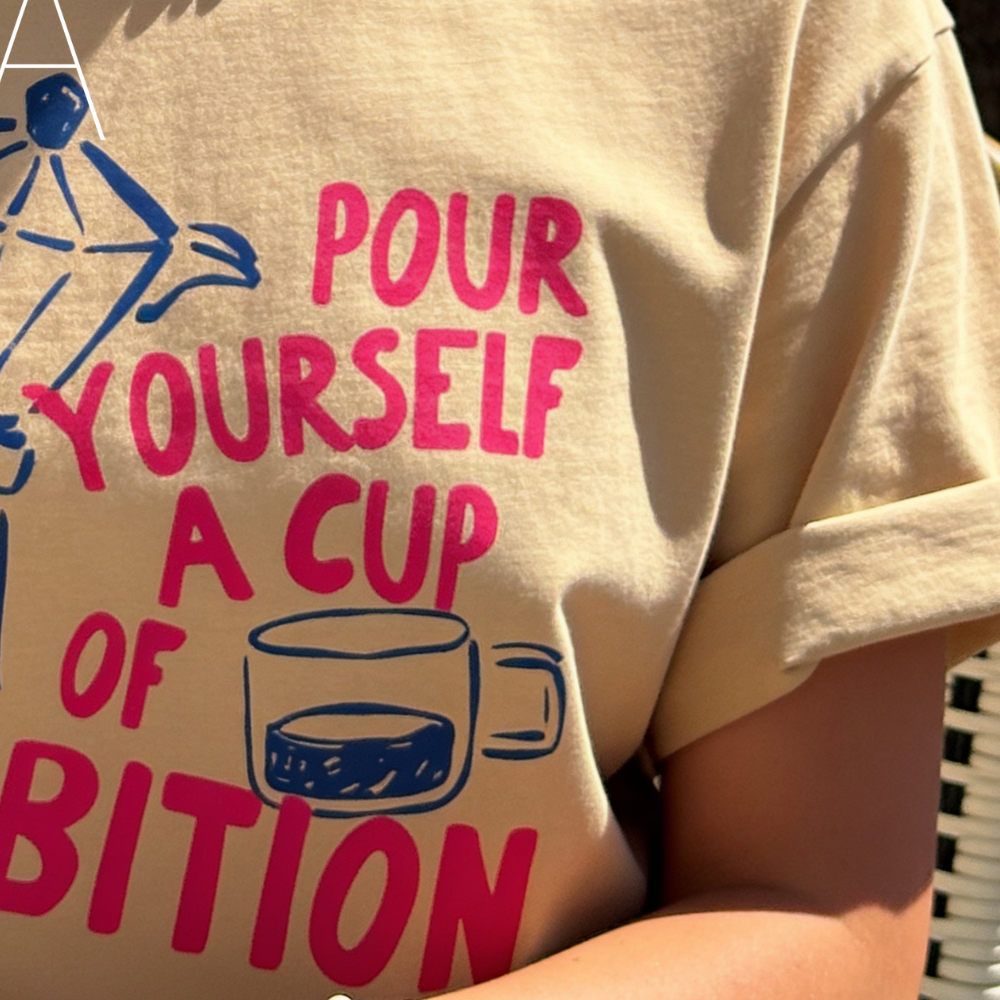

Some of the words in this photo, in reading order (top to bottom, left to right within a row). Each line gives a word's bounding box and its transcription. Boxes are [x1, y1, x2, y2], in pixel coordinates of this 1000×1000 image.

[312, 181, 588, 318] POUR
[22, 328, 583, 492] YOURSELF
[158, 484, 254, 608] A
[283, 473, 499, 612] CUP
[59, 611, 187, 730] OF
